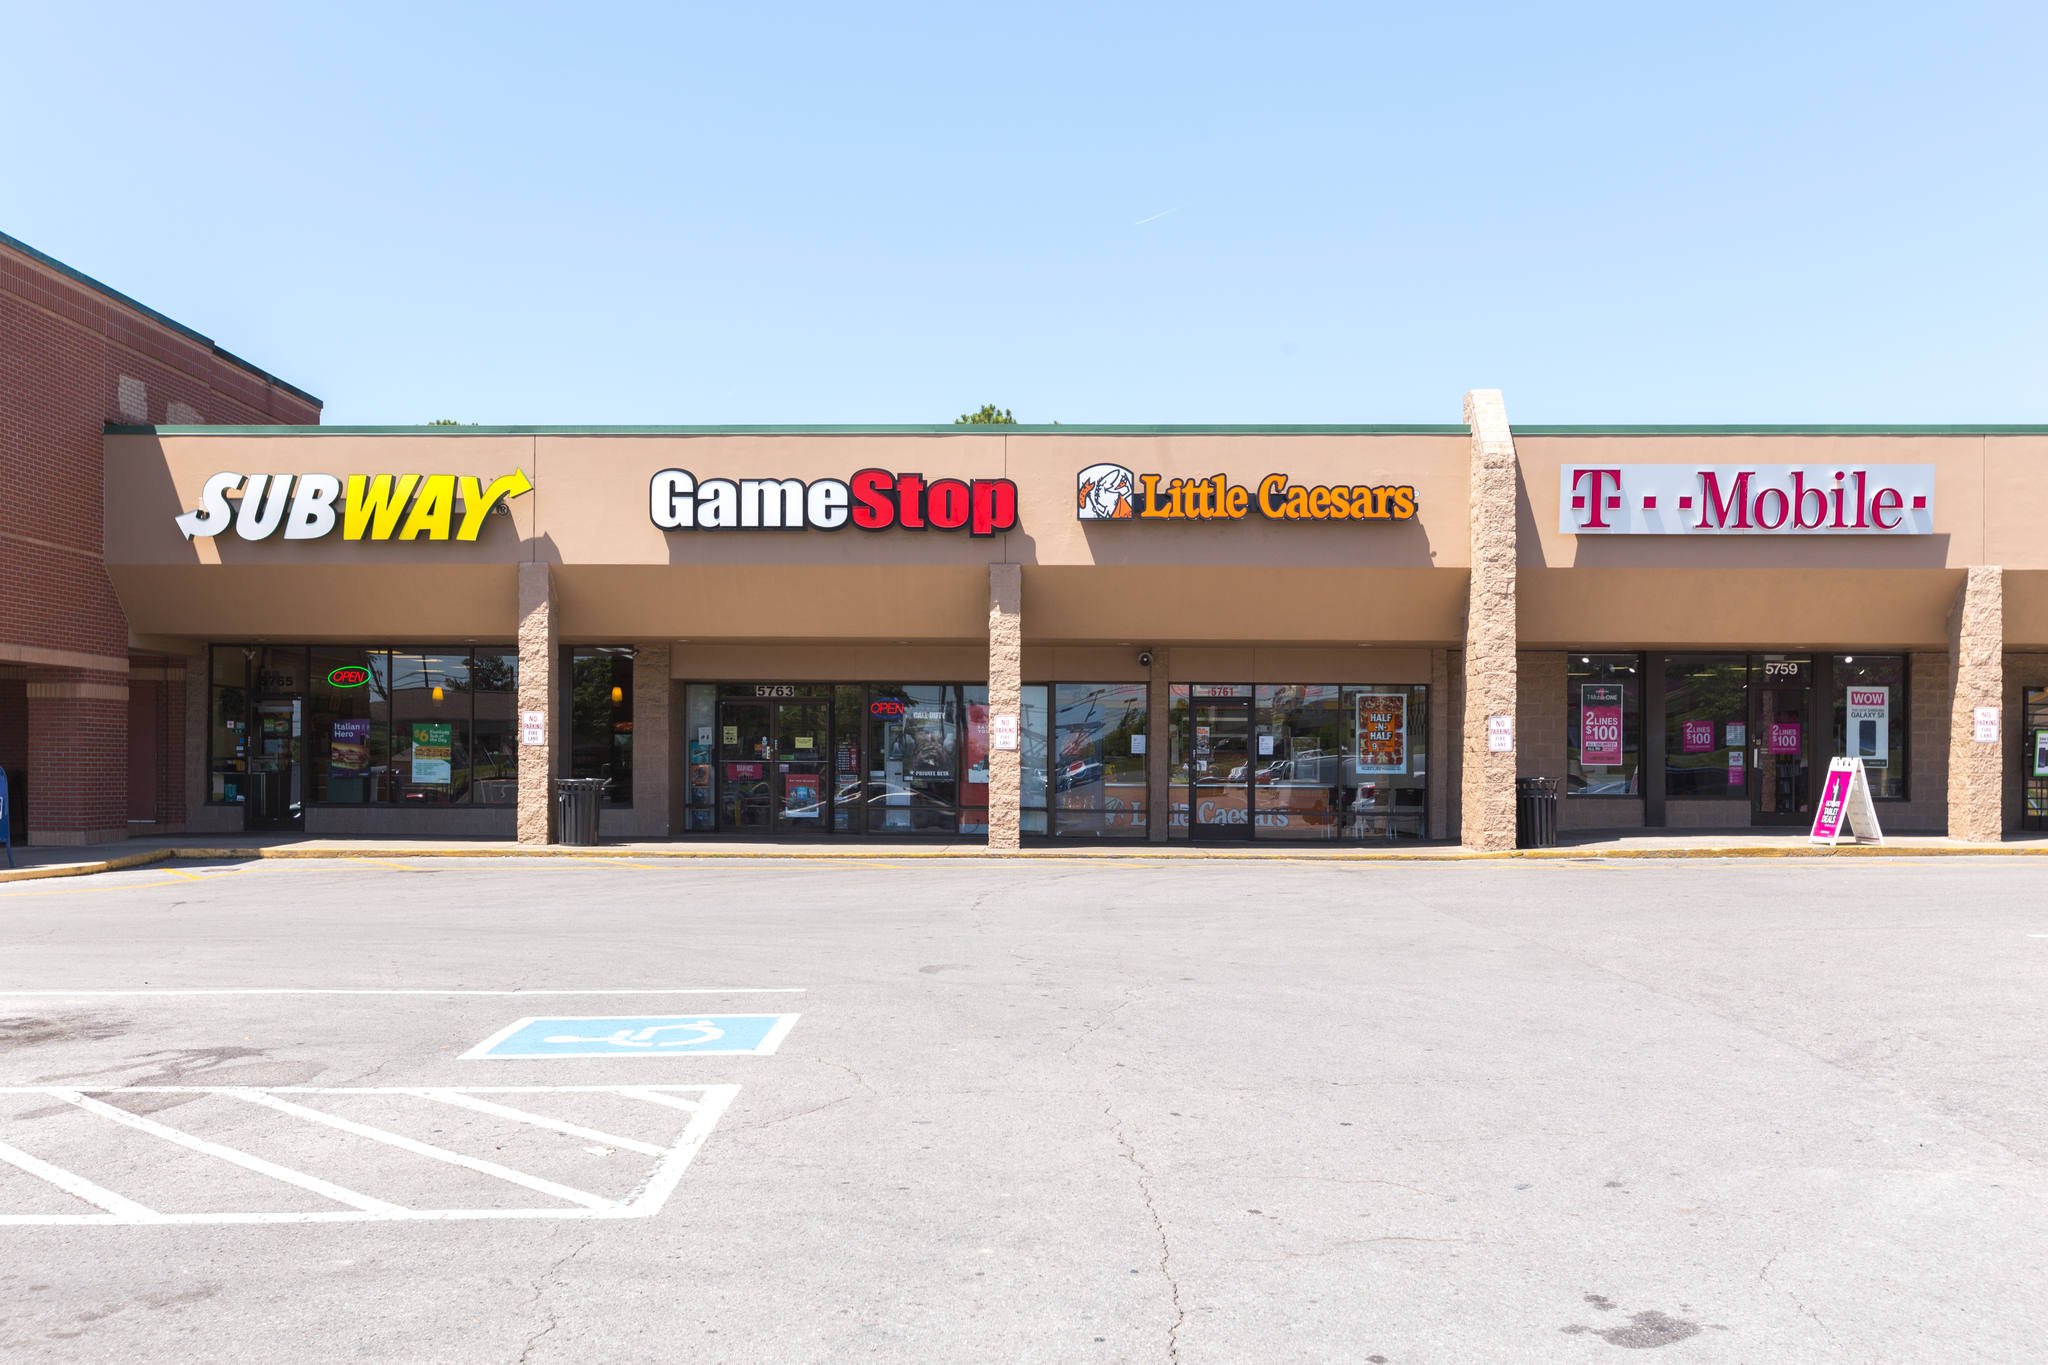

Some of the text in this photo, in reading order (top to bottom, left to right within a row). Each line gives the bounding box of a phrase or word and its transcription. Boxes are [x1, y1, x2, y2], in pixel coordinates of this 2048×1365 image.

[1139, 473, 1417, 520] Little Caesars
[175, 467, 533, 541] SUBWAY
[650, 468, 1017, 538] GameStop
[1765, 663, 1798, 675] 5759
[333, 671, 365, 682] OPEN
[757, 686, 794, 697] 5763
[1211, 687, 1234, 697] 5761
[1853, 693, 1883, 704] WOW
[870, 702, 904, 714] OPEN
[1370, 713, 1392, 722] HALF
[1586, 711, 1594, 725] 2
[334, 722, 360, 730] Italian
[334, 730, 354, 738] Hero
[1370, 732, 1392, 741] HALF
[1585, 726, 1618, 740] $100
[1686, 734, 1711, 744] $100
[1773, 736, 1797, 746] $100
